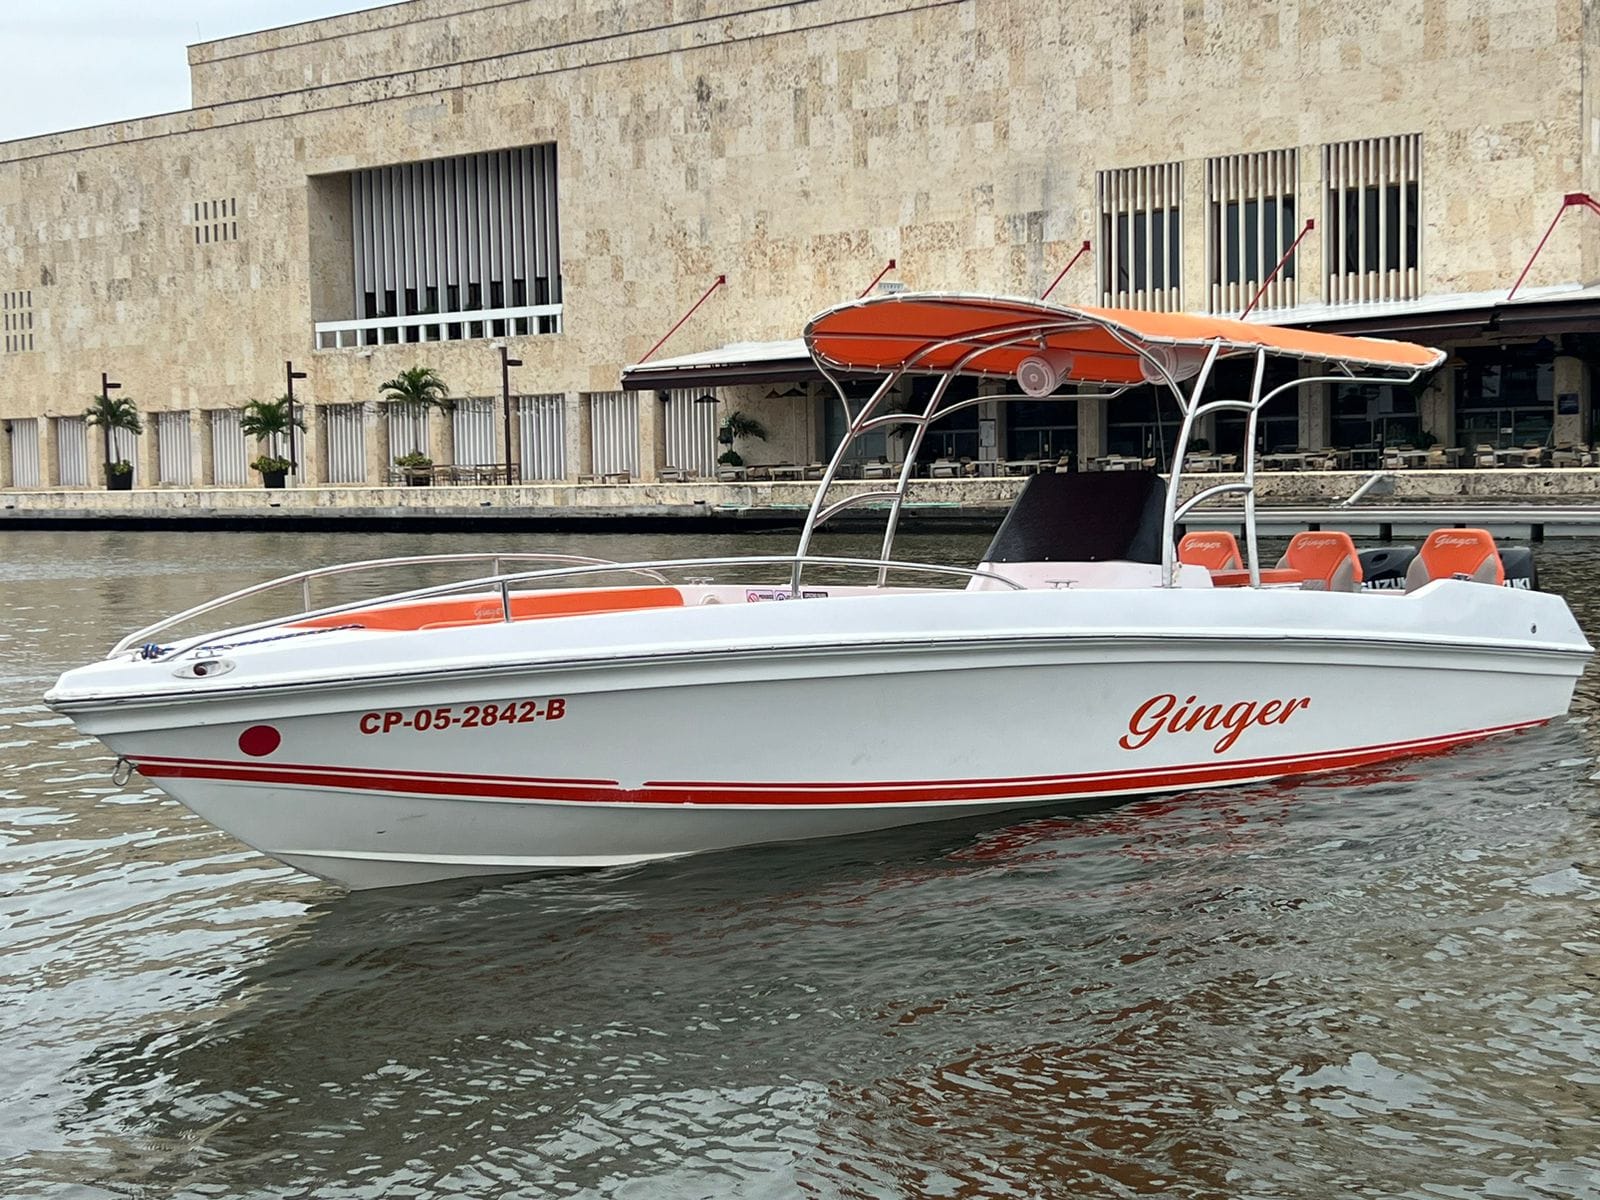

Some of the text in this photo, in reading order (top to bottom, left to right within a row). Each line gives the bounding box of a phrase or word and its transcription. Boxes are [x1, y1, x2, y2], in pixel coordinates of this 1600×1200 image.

[1184, 538, 1222, 552] Ginger
[359, 697, 566, 735] CP-05-2842-B
[1119, 693, 1311, 754] Ginger
